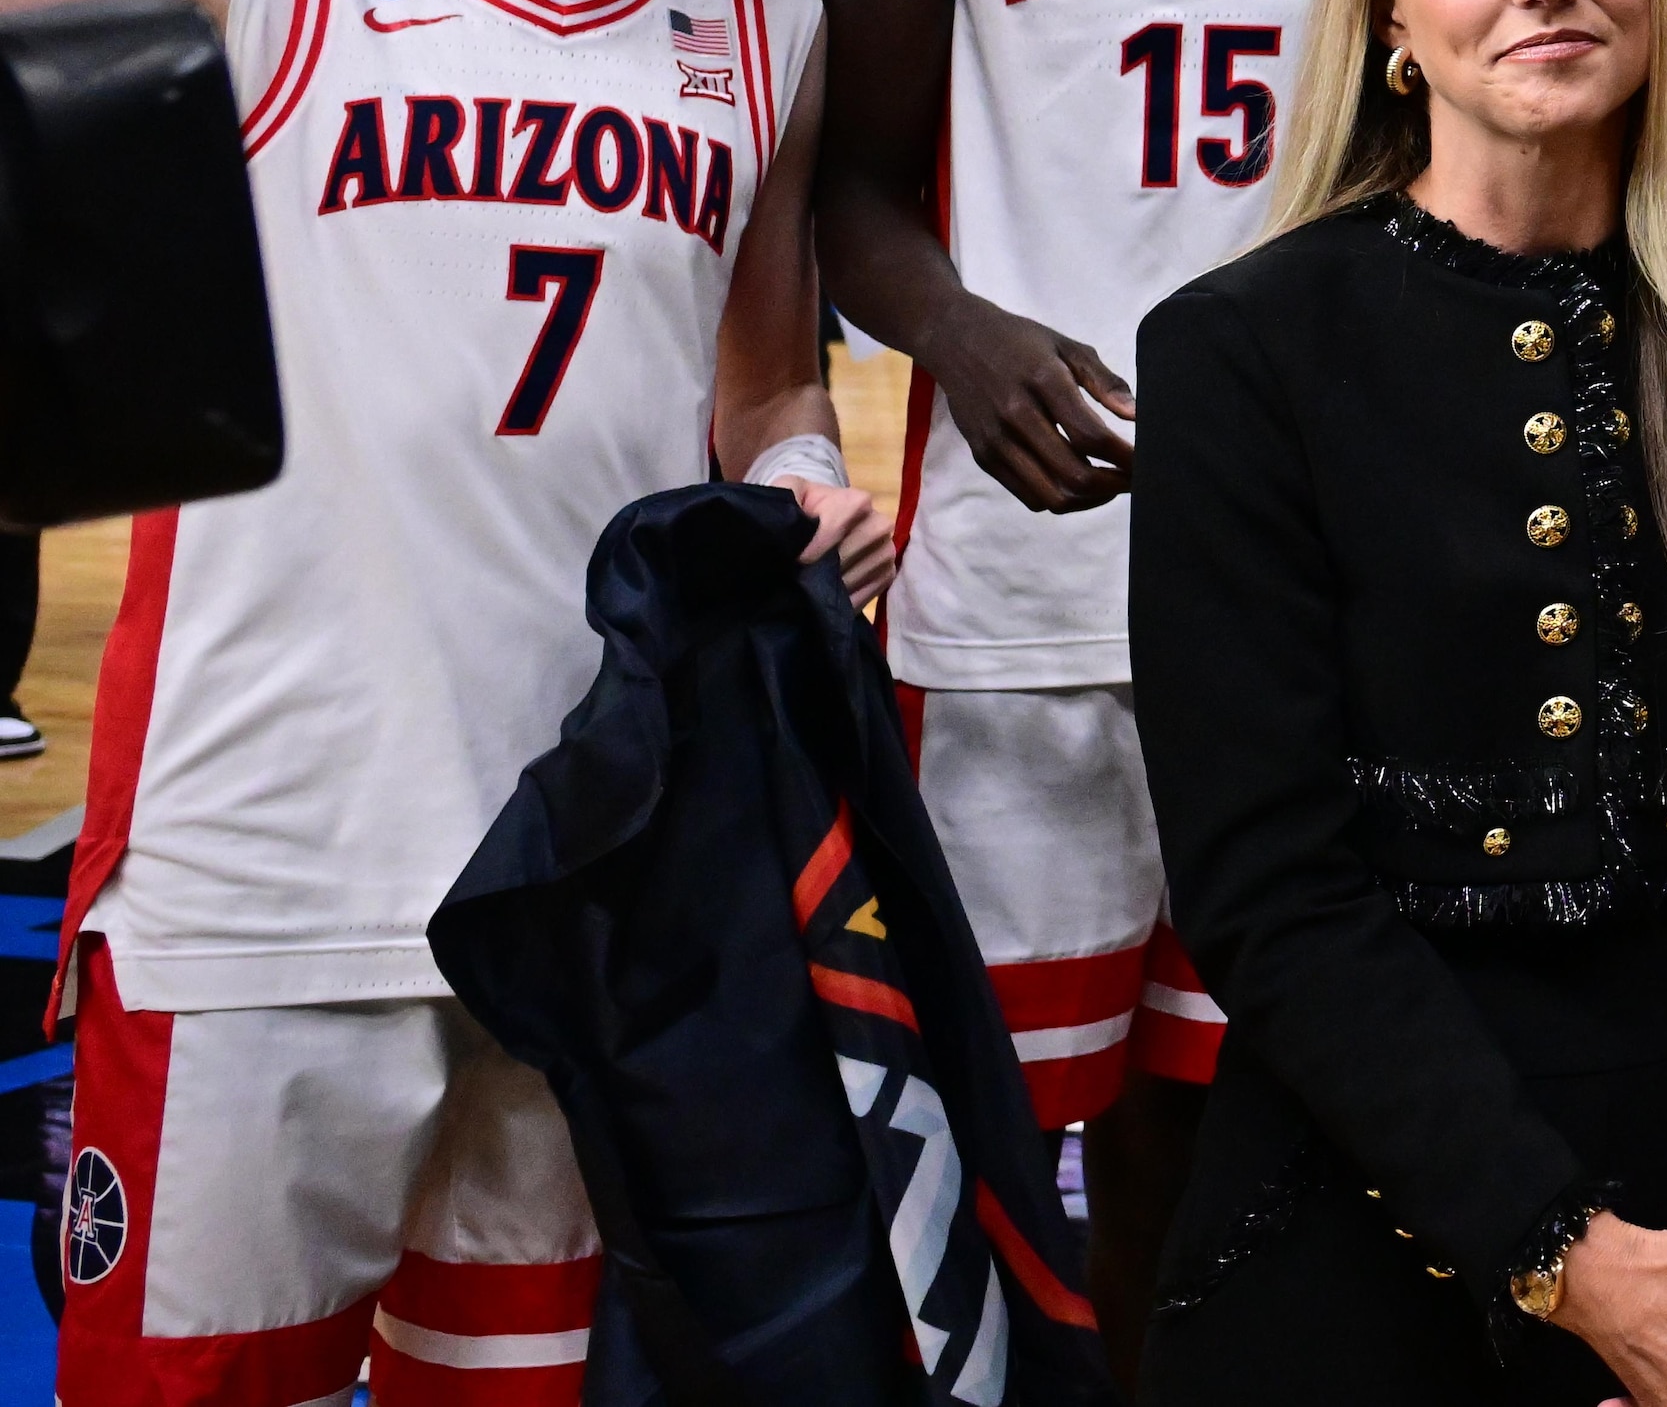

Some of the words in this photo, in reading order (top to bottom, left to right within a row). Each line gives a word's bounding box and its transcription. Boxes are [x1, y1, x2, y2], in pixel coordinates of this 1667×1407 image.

[317, 95, 734, 256] ARIZONA
[1120, 22, 1282, 189] 15
[494, 243, 606, 436] 7
[74, 1189, 97, 1242] A
